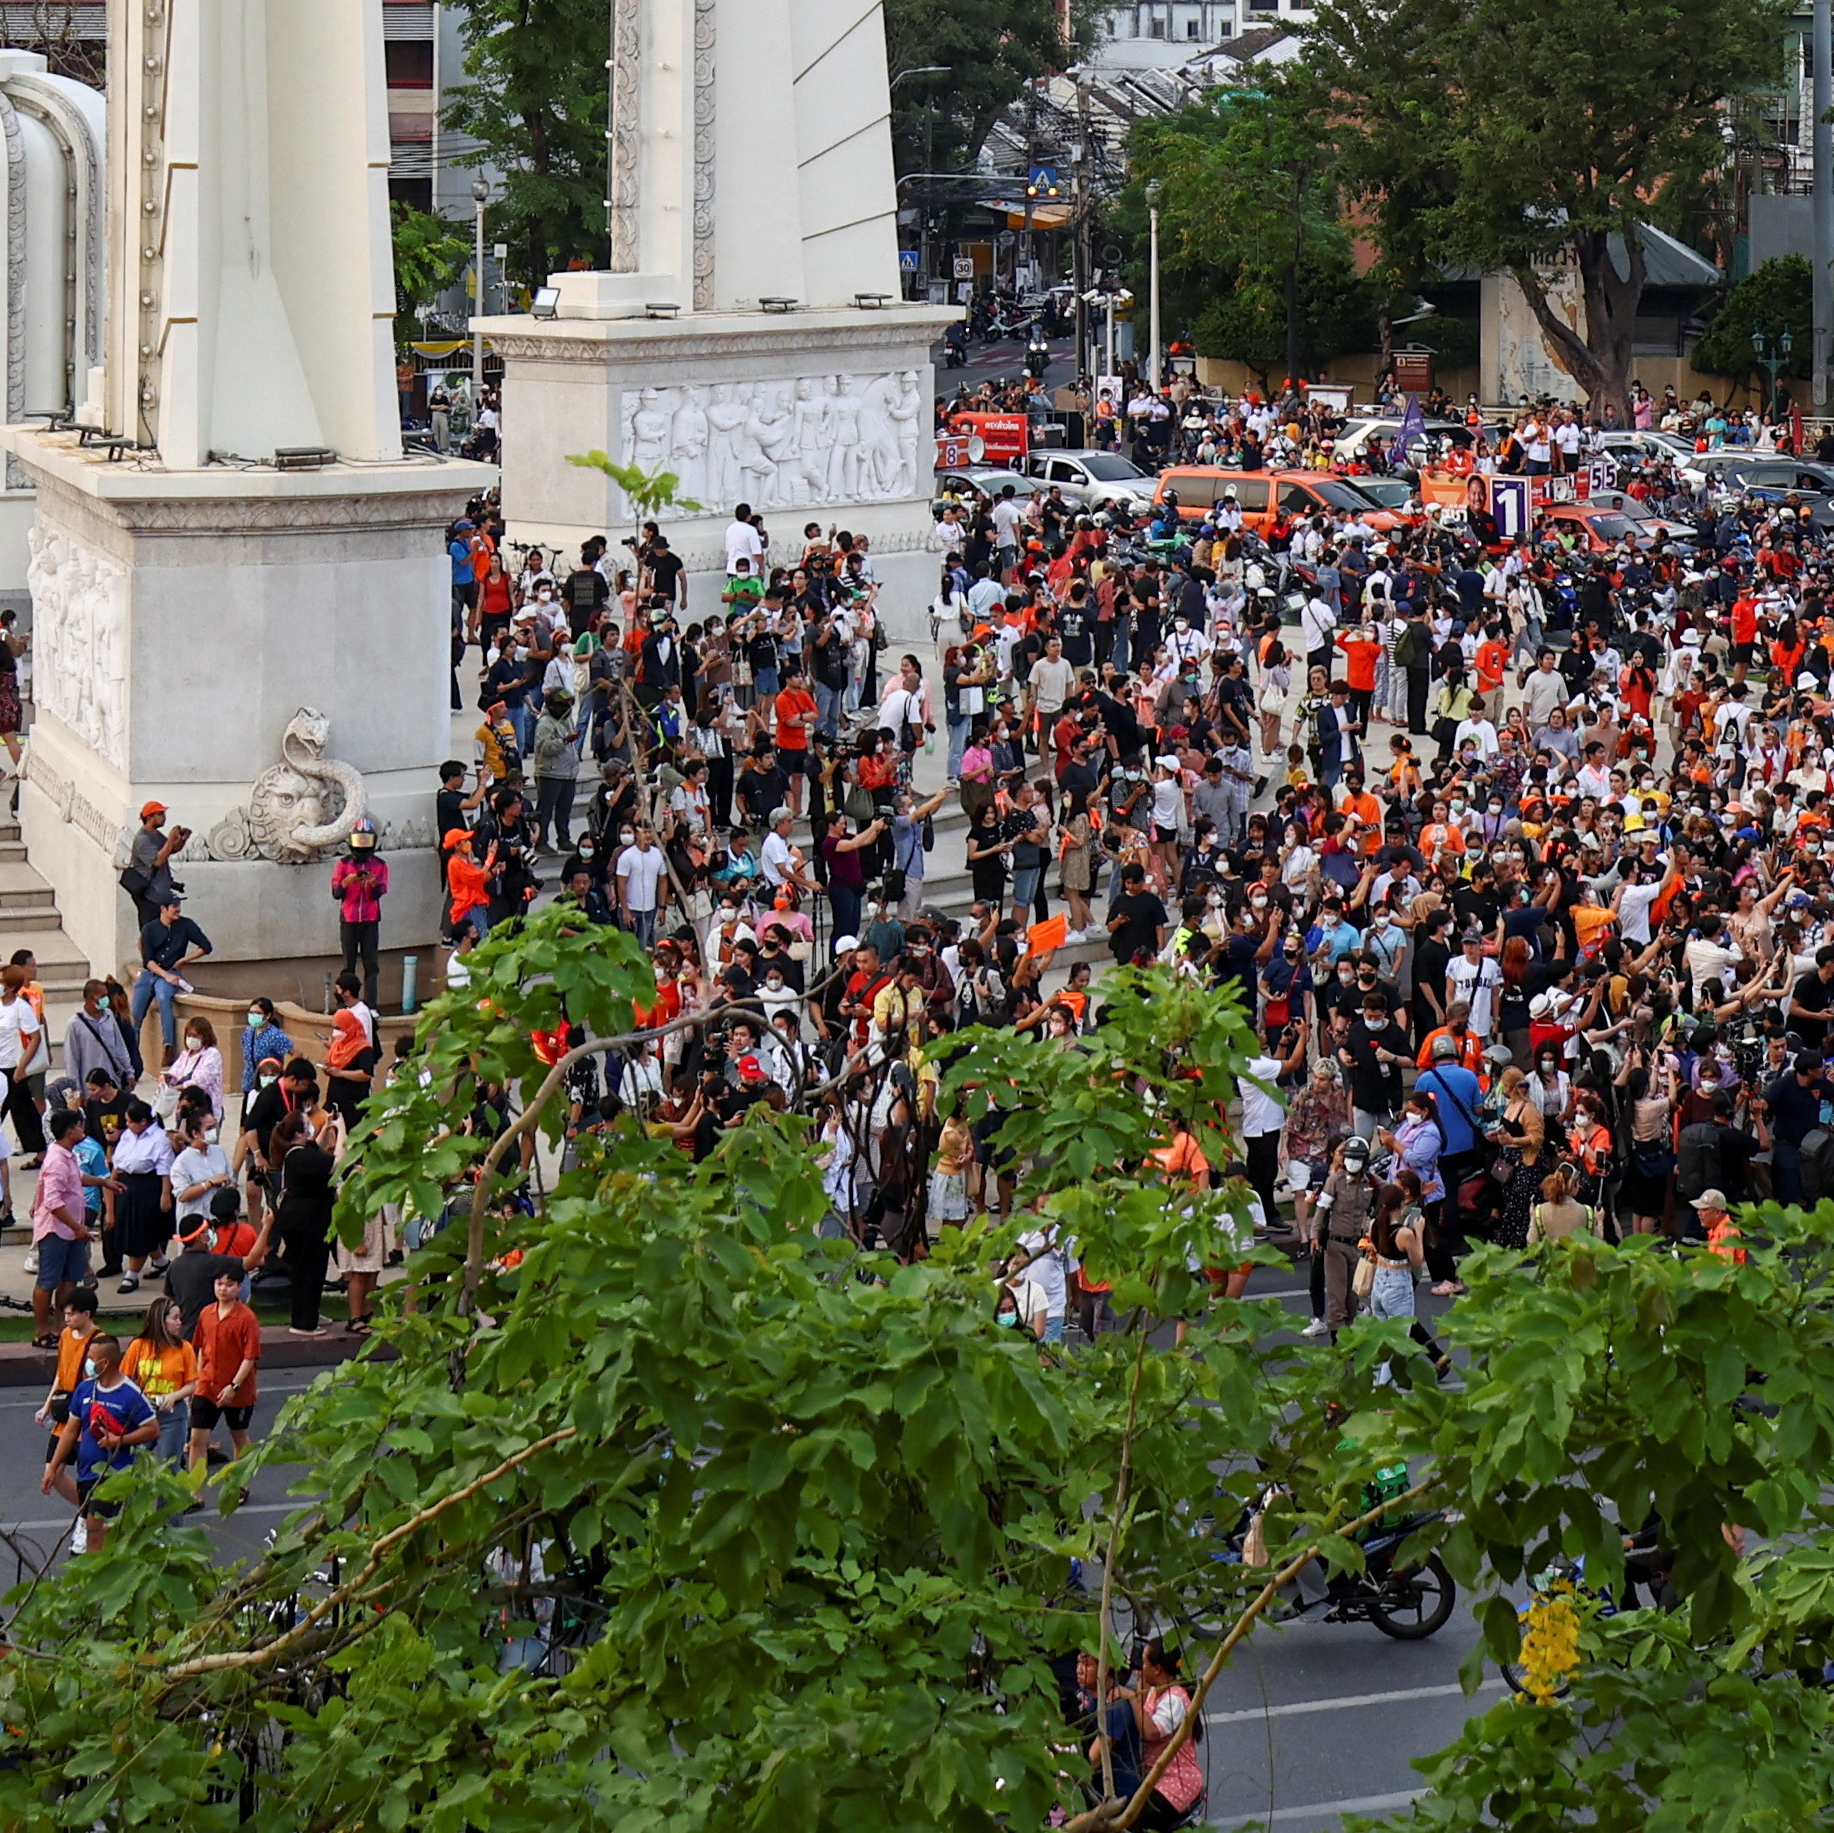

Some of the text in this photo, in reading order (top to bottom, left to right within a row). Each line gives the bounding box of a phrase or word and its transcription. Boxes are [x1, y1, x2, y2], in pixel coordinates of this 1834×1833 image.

[958, 264, 969, 272] 30
[947, 447, 956, 465] 8
[1011, 454, 1023, 472] 4
[1592, 466, 1615, 489] 5 5
[1497, 489, 1517, 536] 1
